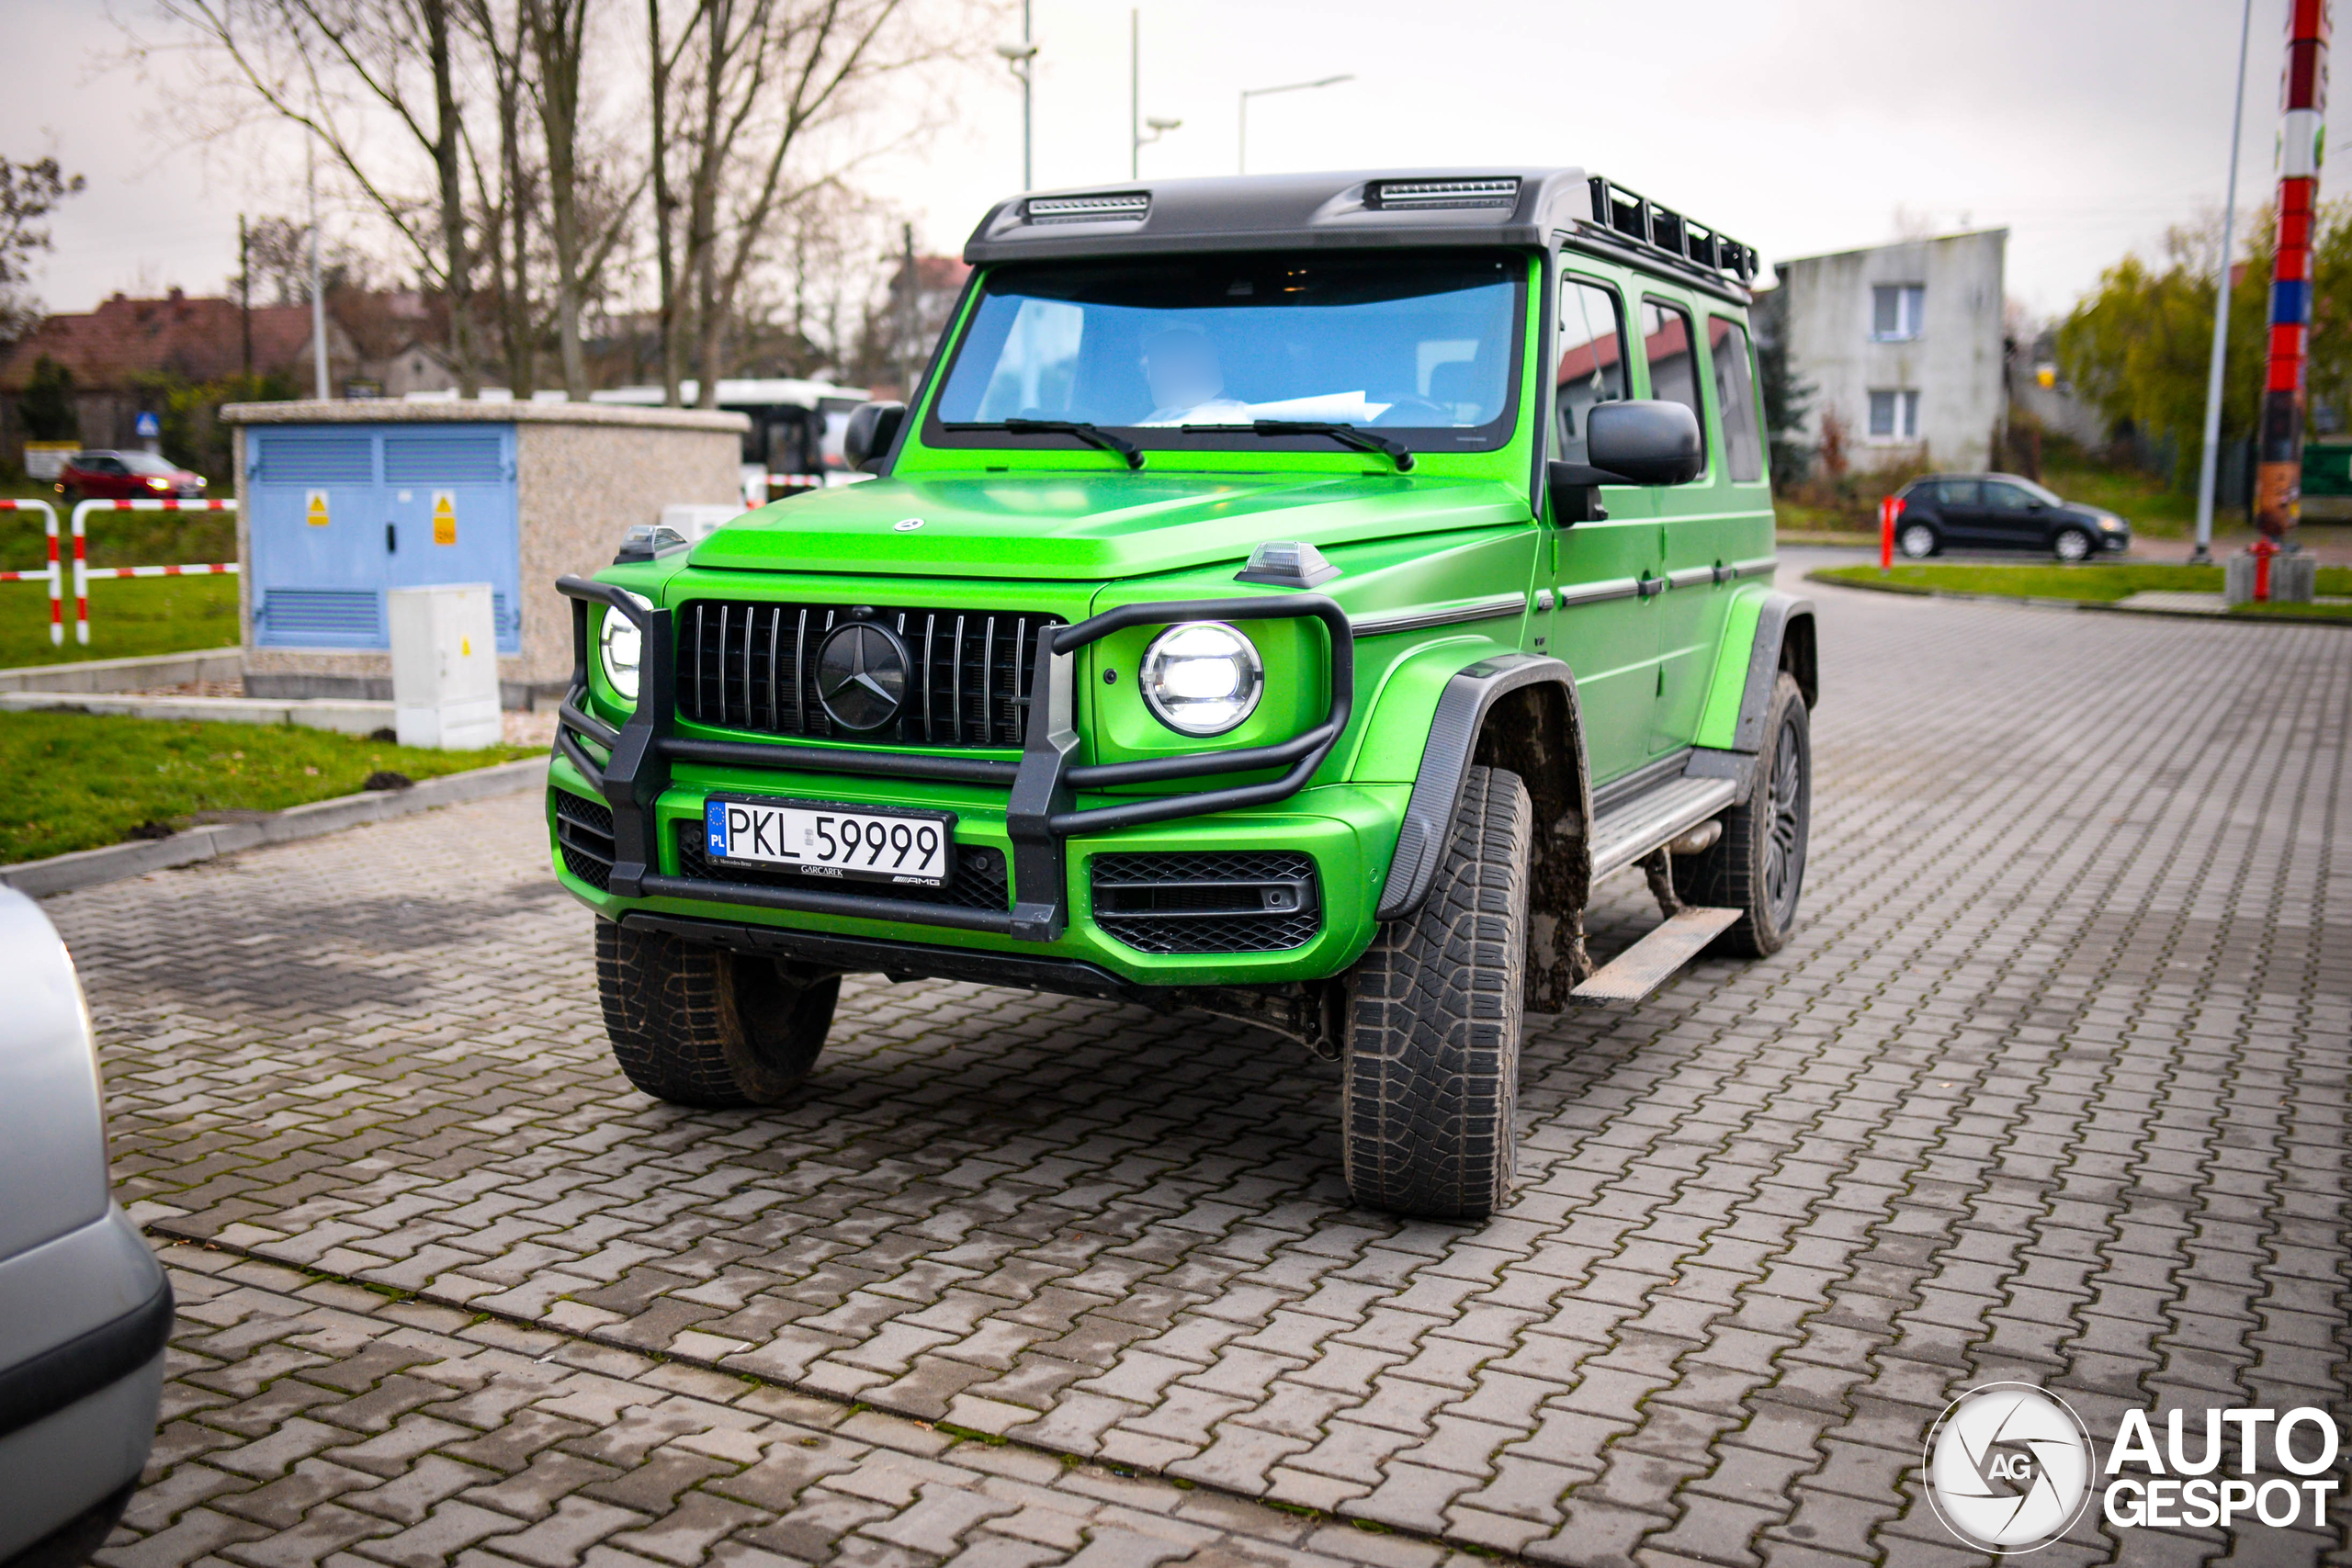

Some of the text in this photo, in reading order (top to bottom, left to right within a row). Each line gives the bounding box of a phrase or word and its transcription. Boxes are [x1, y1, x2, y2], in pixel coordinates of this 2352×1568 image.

[711, 834, 725, 847] PL
[729, 808, 938, 870] PKL 59999
[720, 858, 752, 867] Mercedes-Benz
[907, 878, 940, 886] AMG
